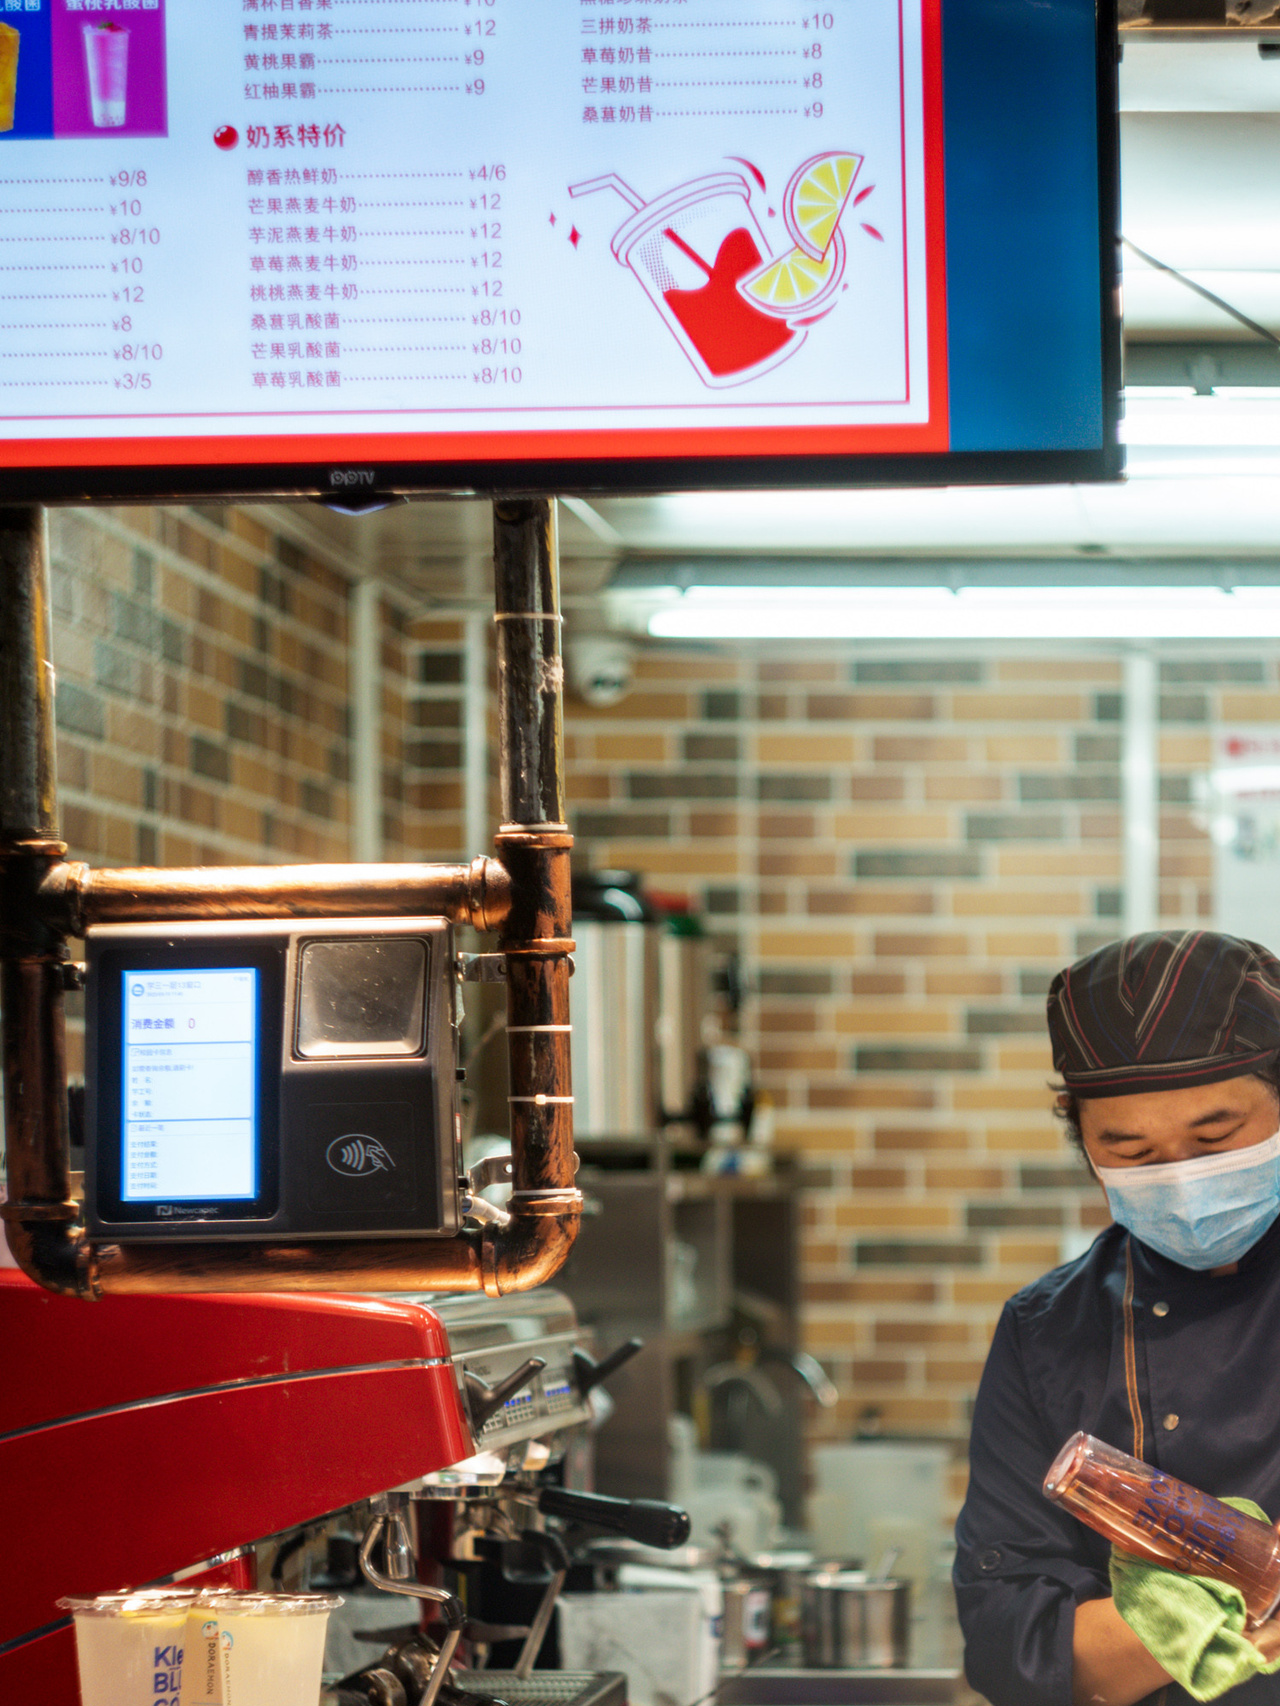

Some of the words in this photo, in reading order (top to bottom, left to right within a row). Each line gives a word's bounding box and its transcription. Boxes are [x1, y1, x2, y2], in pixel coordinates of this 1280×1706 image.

[244, 23, 333, 41] 青提茉莉茶
[464, 19, 496, 37] ¥12
[580, 17, 652, 35] 三拼奶茶
[802, 13, 834, 31] ¥10
[244, 53, 315, 71] 黄桃果霸
[465, 49, 485, 67] ¥9
[581, 47, 653, 64] 草莓奶昔
[803, 43, 822, 60] ¥8
[244, 82, 317, 100] 红柚果霸
[465, 78, 485, 96] ¥9
[581, 76, 653, 94] 芒果奶昔
[803, 72, 823, 89] ¥8
[804, 102, 823, 119] ¥9
[246, 123, 346, 149] 奶系特价
[109, 169, 148, 188] ¥9/8
[247, 168, 338, 187] 醇香热鲜奶
[469, 164, 507, 183] ¥4/6
[109, 200, 142, 218] ¥10
[248, 197, 357, 216] 芒果燕麦牛奶
[469, 194, 502, 212] ¥12
[110, 228, 161, 247] ¥8/10
[248, 226, 358, 244] 芋泥燕麦牛奶
[470, 223, 502, 241] ¥12
[111, 257, 143, 276] ¥10
[249, 255, 358, 273] 草莓燕麦牛奶
[470, 252, 503, 270] ¥12
[111, 286, 144, 304] ¥12
[250, 284, 359, 302] 桃桃燕麦牛奶
[471, 280, 503, 299] ¥12
[112, 316, 133, 333] ¥8
[471, 309, 521, 327] ¥8/10
[113, 344, 163, 363] ¥8/10
[251, 342, 341, 360] 芒果乳酸菌
[472, 338, 522, 356] ¥8/10
[113, 373, 152, 392] ¥3/5
[252, 371, 342, 389] 草莓乳酸菌
[472, 367, 522, 385] ¥8/10
